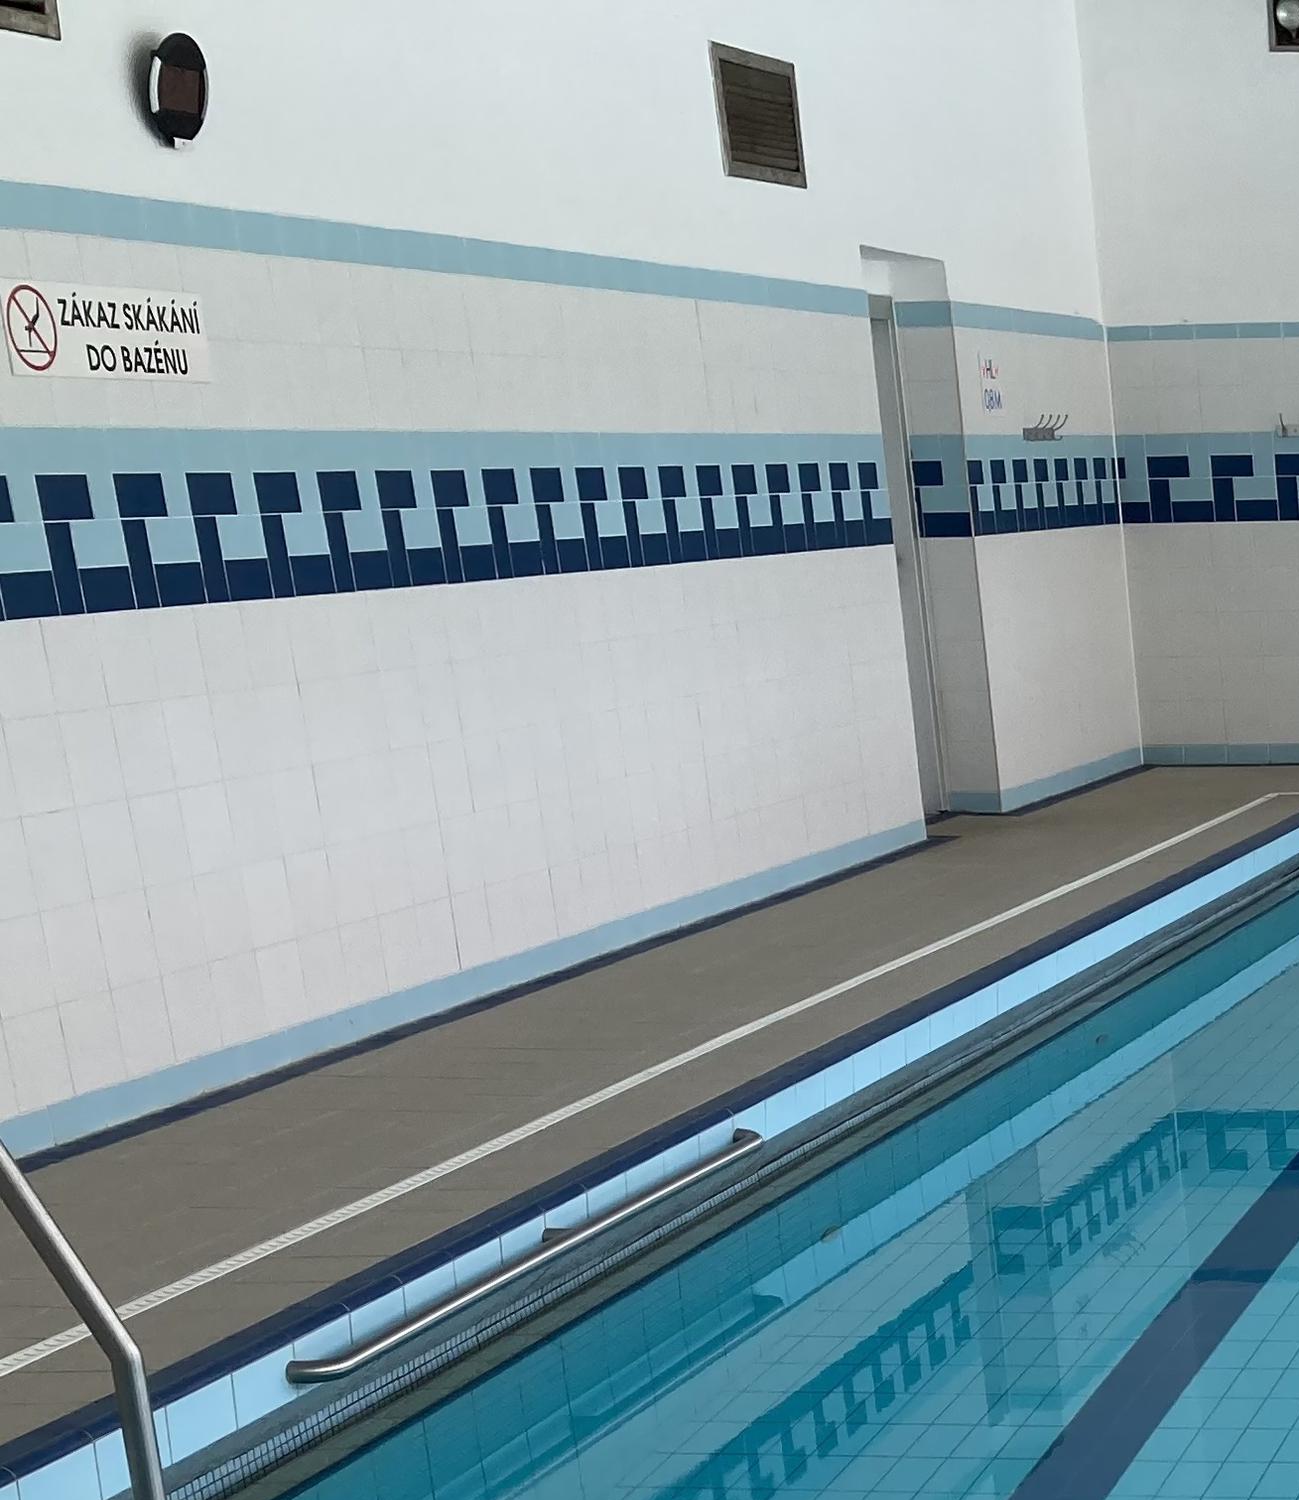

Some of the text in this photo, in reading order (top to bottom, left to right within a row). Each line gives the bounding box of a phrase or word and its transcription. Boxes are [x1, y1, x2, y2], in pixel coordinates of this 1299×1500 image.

[57, 292, 201, 335] ZÁKAZ SKÁKÁNÍ
[86, 340, 189, 375] DO BAZÉNU
